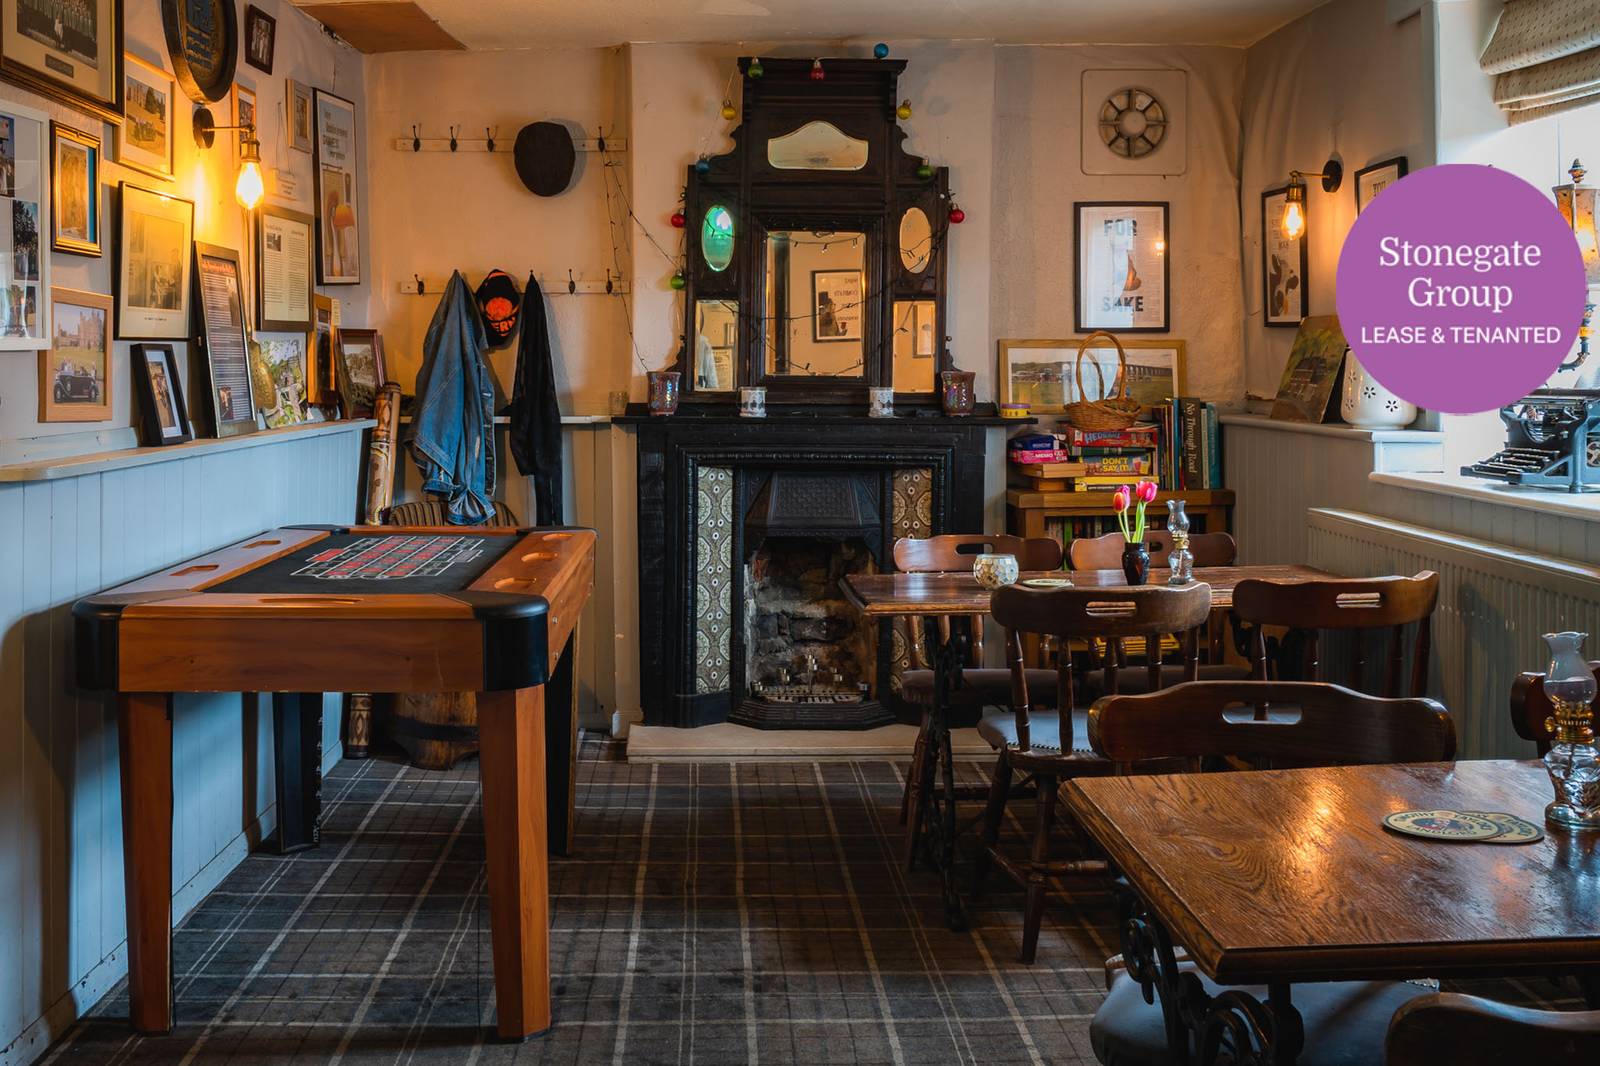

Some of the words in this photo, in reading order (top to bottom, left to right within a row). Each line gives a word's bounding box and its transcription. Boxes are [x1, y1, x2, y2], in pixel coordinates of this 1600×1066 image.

[1102, 295, 1144, 312] SAKE
[1186, 402, 1196, 415] No
[1186, 418, 1198, 450] Through
[1102, 457, 1129, 466] DON'T
[1102, 465, 1118, 473] SAY
[1187, 453, 1199, 473] Road
